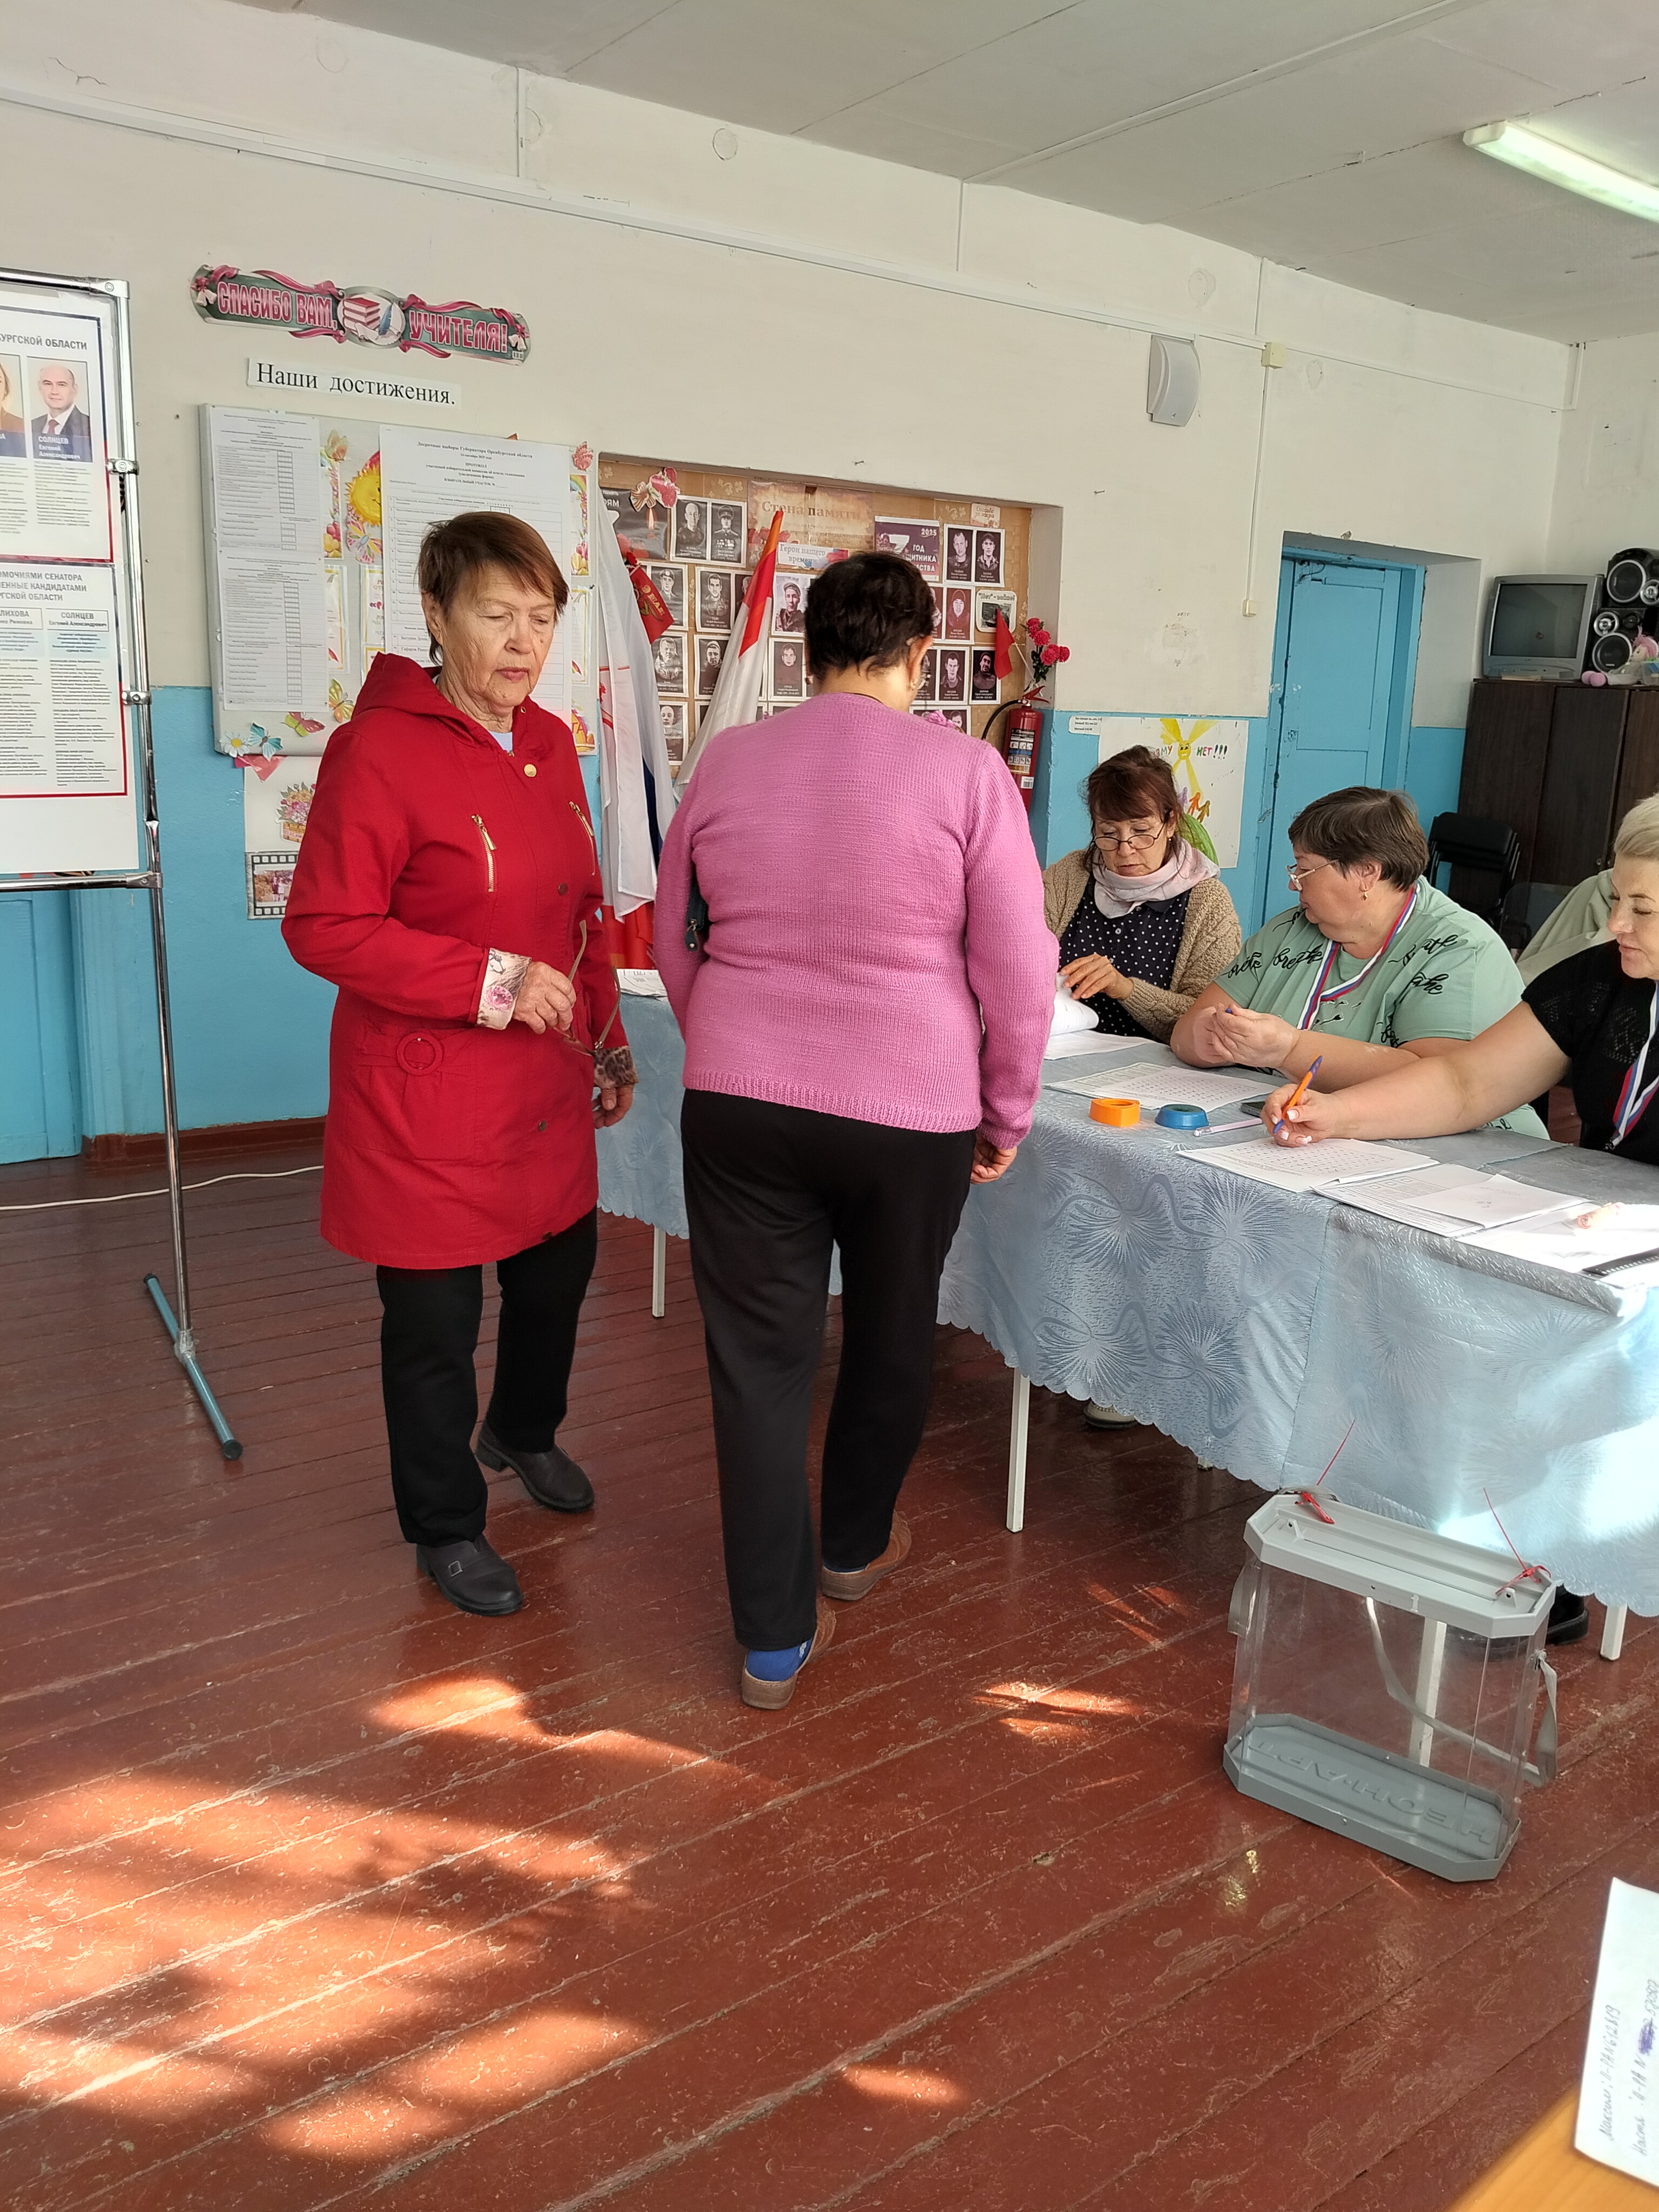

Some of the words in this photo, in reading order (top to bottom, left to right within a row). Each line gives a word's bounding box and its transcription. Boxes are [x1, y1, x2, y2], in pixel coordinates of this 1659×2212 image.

[217, 281, 291, 322] СПАСИБО
[296, 294, 338, 331] ВАМ,
[408, 310, 508, 353] УЧИТЕЛЯ!
[45, 339, 87, 350] ОБЛАСТИ
[257, 363, 318, 390] Наши
[330, 377, 456, 406] достижения.
[38, 436, 69, 444] СОЛНЦЕВ
[762, 501, 804, 515] Стена
[921, 528, 937, 536] 2025
[780, 544, 800, 554] Герои
[801, 548, 826, 556] нашего
[913, 544, 925, 552] ГОД
[45, 573, 83, 582] СЕНАТОРА
[30, 583, 87, 592] КАНДИДАТАМИ
